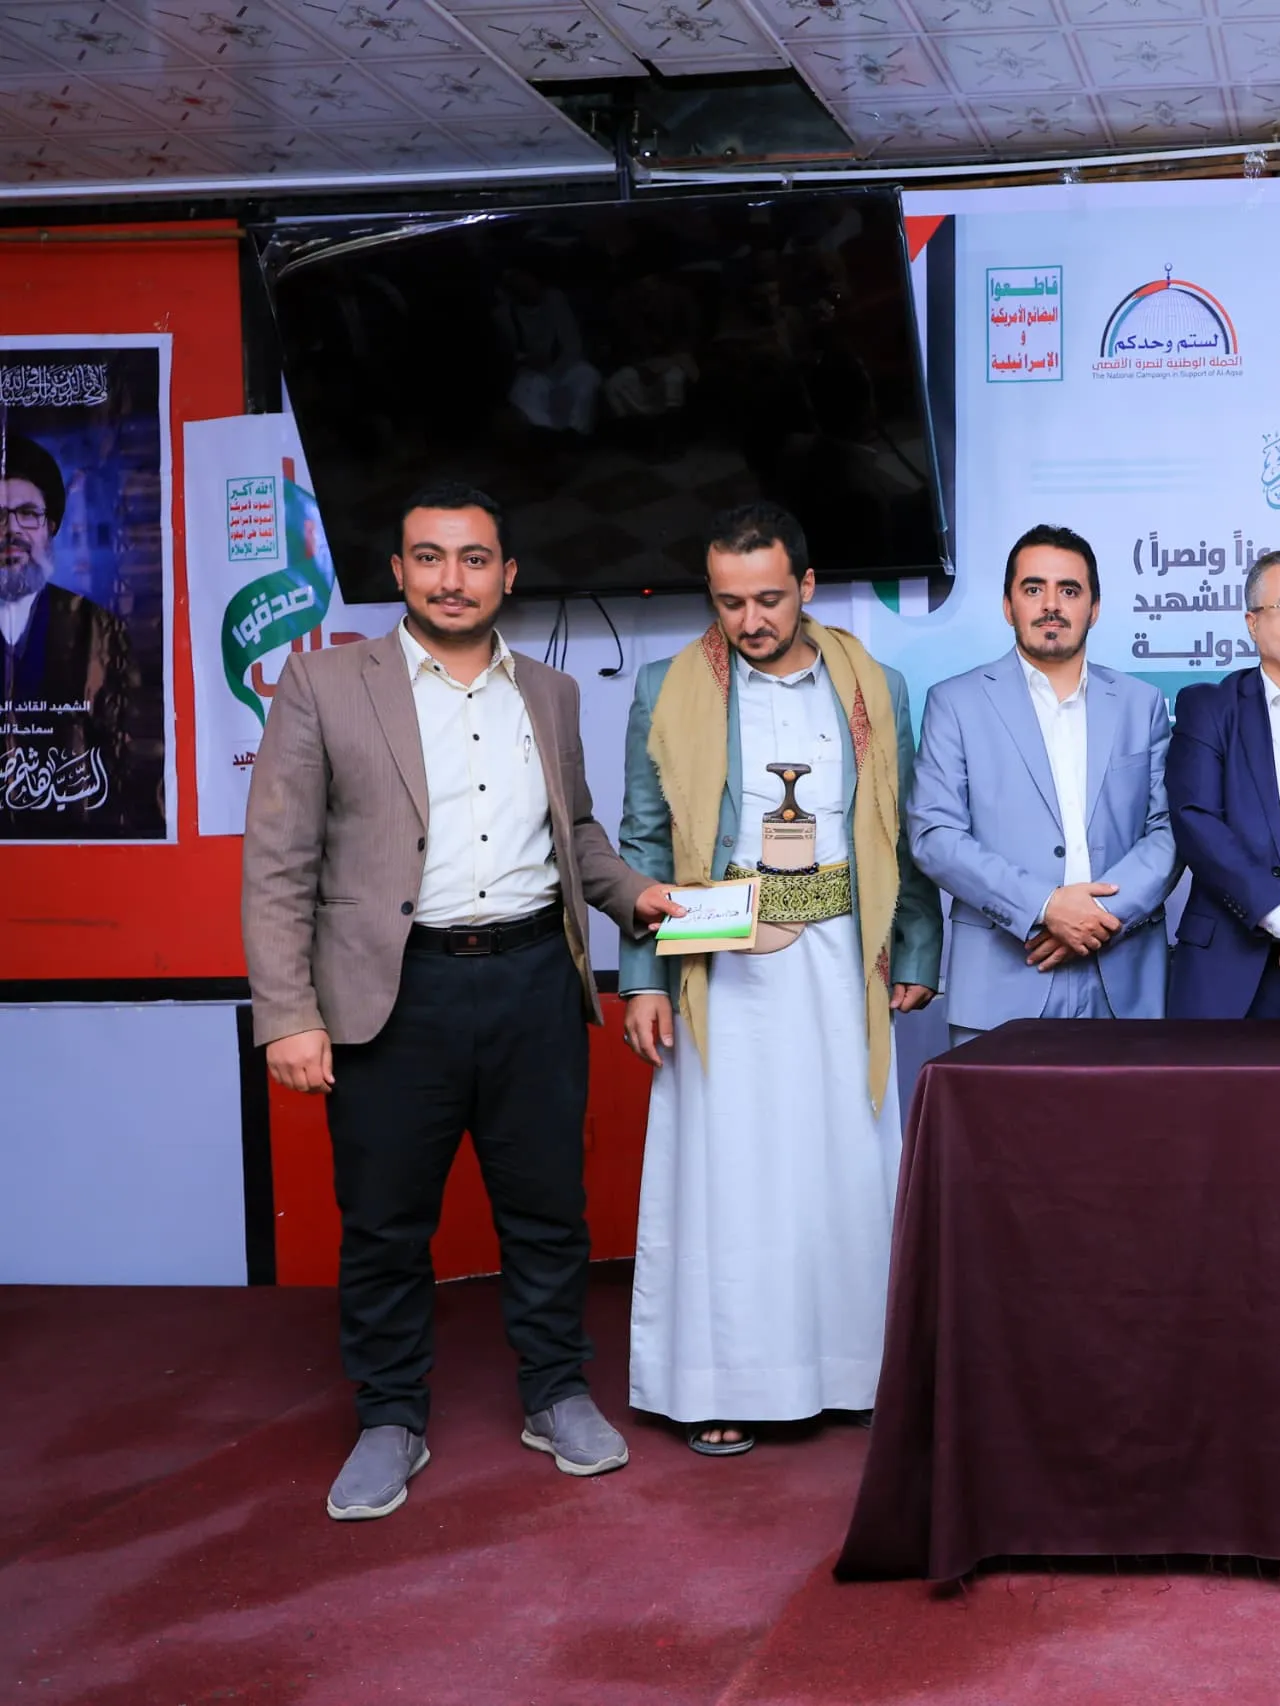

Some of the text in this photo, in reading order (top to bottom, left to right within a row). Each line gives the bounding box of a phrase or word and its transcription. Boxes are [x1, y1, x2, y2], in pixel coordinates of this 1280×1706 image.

[990, 275, 1058, 301] قاطعوا
[1027, 305, 1058, 327] البضائع
[1114, 333, 1219, 353] لستم وحدكم
[1135, 358, 1163, 370] لنصرة
[1166, 357, 1206, 370] الوطنية
[1209, 356, 1243, 367] الحملة
[1106, 371, 1134, 379] National
[1136, 371, 1170, 381] Campaign
[1180, 370, 1207, 379] Support
[1133, 579, 1243, 621] للشهيد
[231, 585, 315, 648] صدقوا
[15, 700, 47, 712] القائد
[49, 700, 91, 714] الشهيد
[12, 723, 54, 735] سماحة
